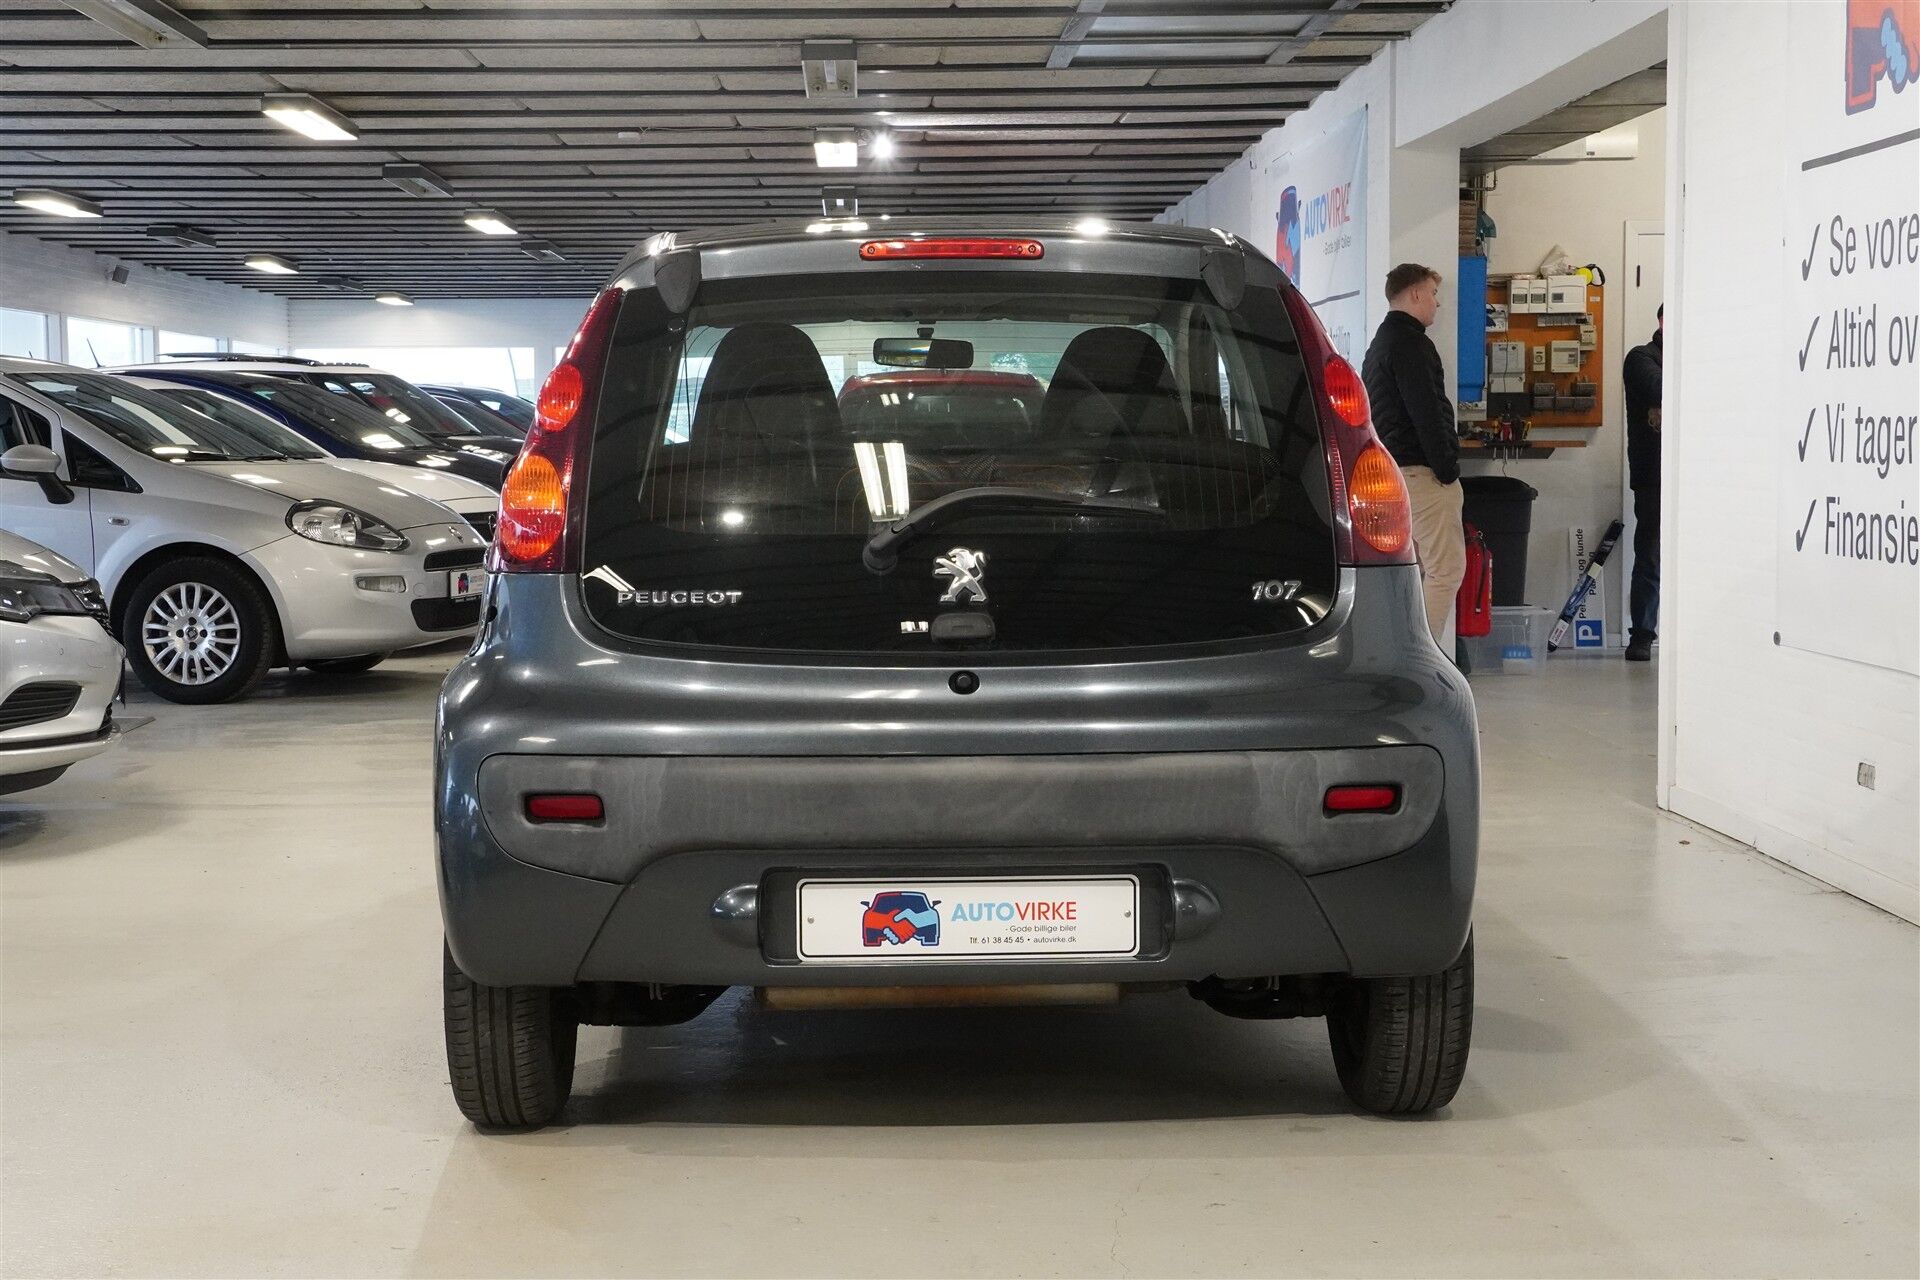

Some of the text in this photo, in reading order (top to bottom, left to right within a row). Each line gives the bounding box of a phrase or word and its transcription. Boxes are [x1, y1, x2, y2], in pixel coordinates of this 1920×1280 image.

[1829, 214, 1857, 277] Se
[1826, 303, 1877, 370] Altid
[1825, 402, 1918, 480] Vi tager
[1575, 528, 1584, 557] kunde
[1825, 496, 1920, 566] Finansie
[617, 589, 742, 604] PEUGEOT
[1252, 580, 1301, 600] 107
[951, 901, 1077, 921] AUTOVIRKE
[1009, 925, 1032, 933] Gode
[1034, 925, 1058, 933] billige
[1060, 924, 1077, 932] biler
